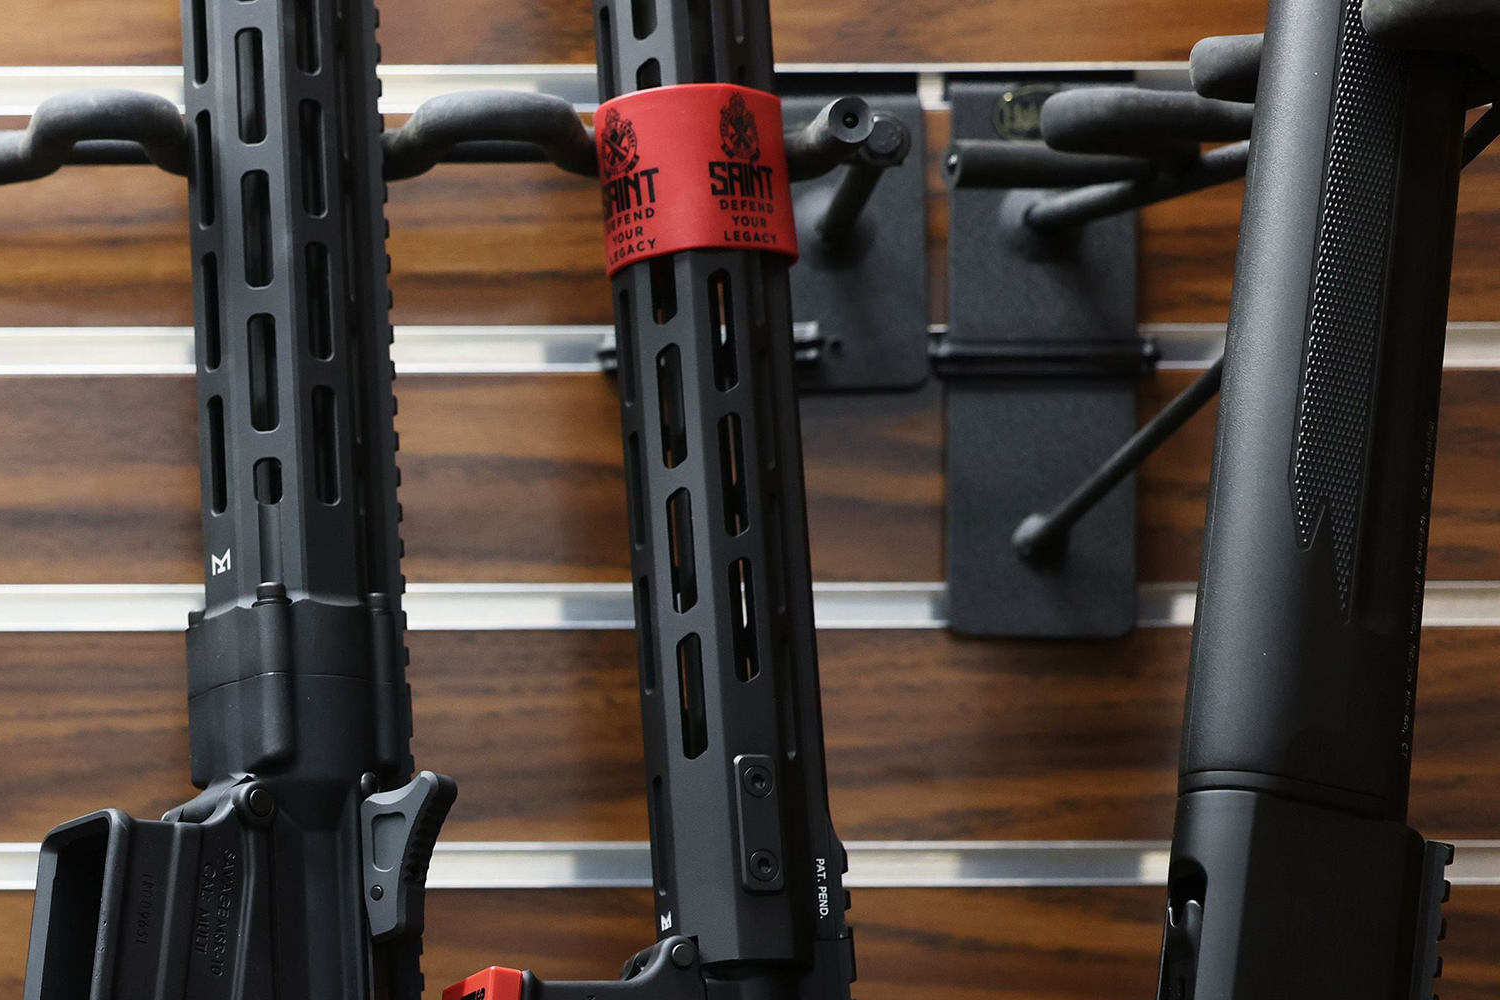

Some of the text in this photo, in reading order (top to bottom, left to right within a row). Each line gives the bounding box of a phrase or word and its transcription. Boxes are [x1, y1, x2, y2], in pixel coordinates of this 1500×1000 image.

[708, 161, 773, 200] SAINT
[720, 199, 774, 214] DEFEND
[732, 215, 767, 228] YOUR
[612, 226, 644, 245] YOUR
[724, 231, 777, 245] LEGACY
[815, 858, 829, 920] PAT. PEND.
